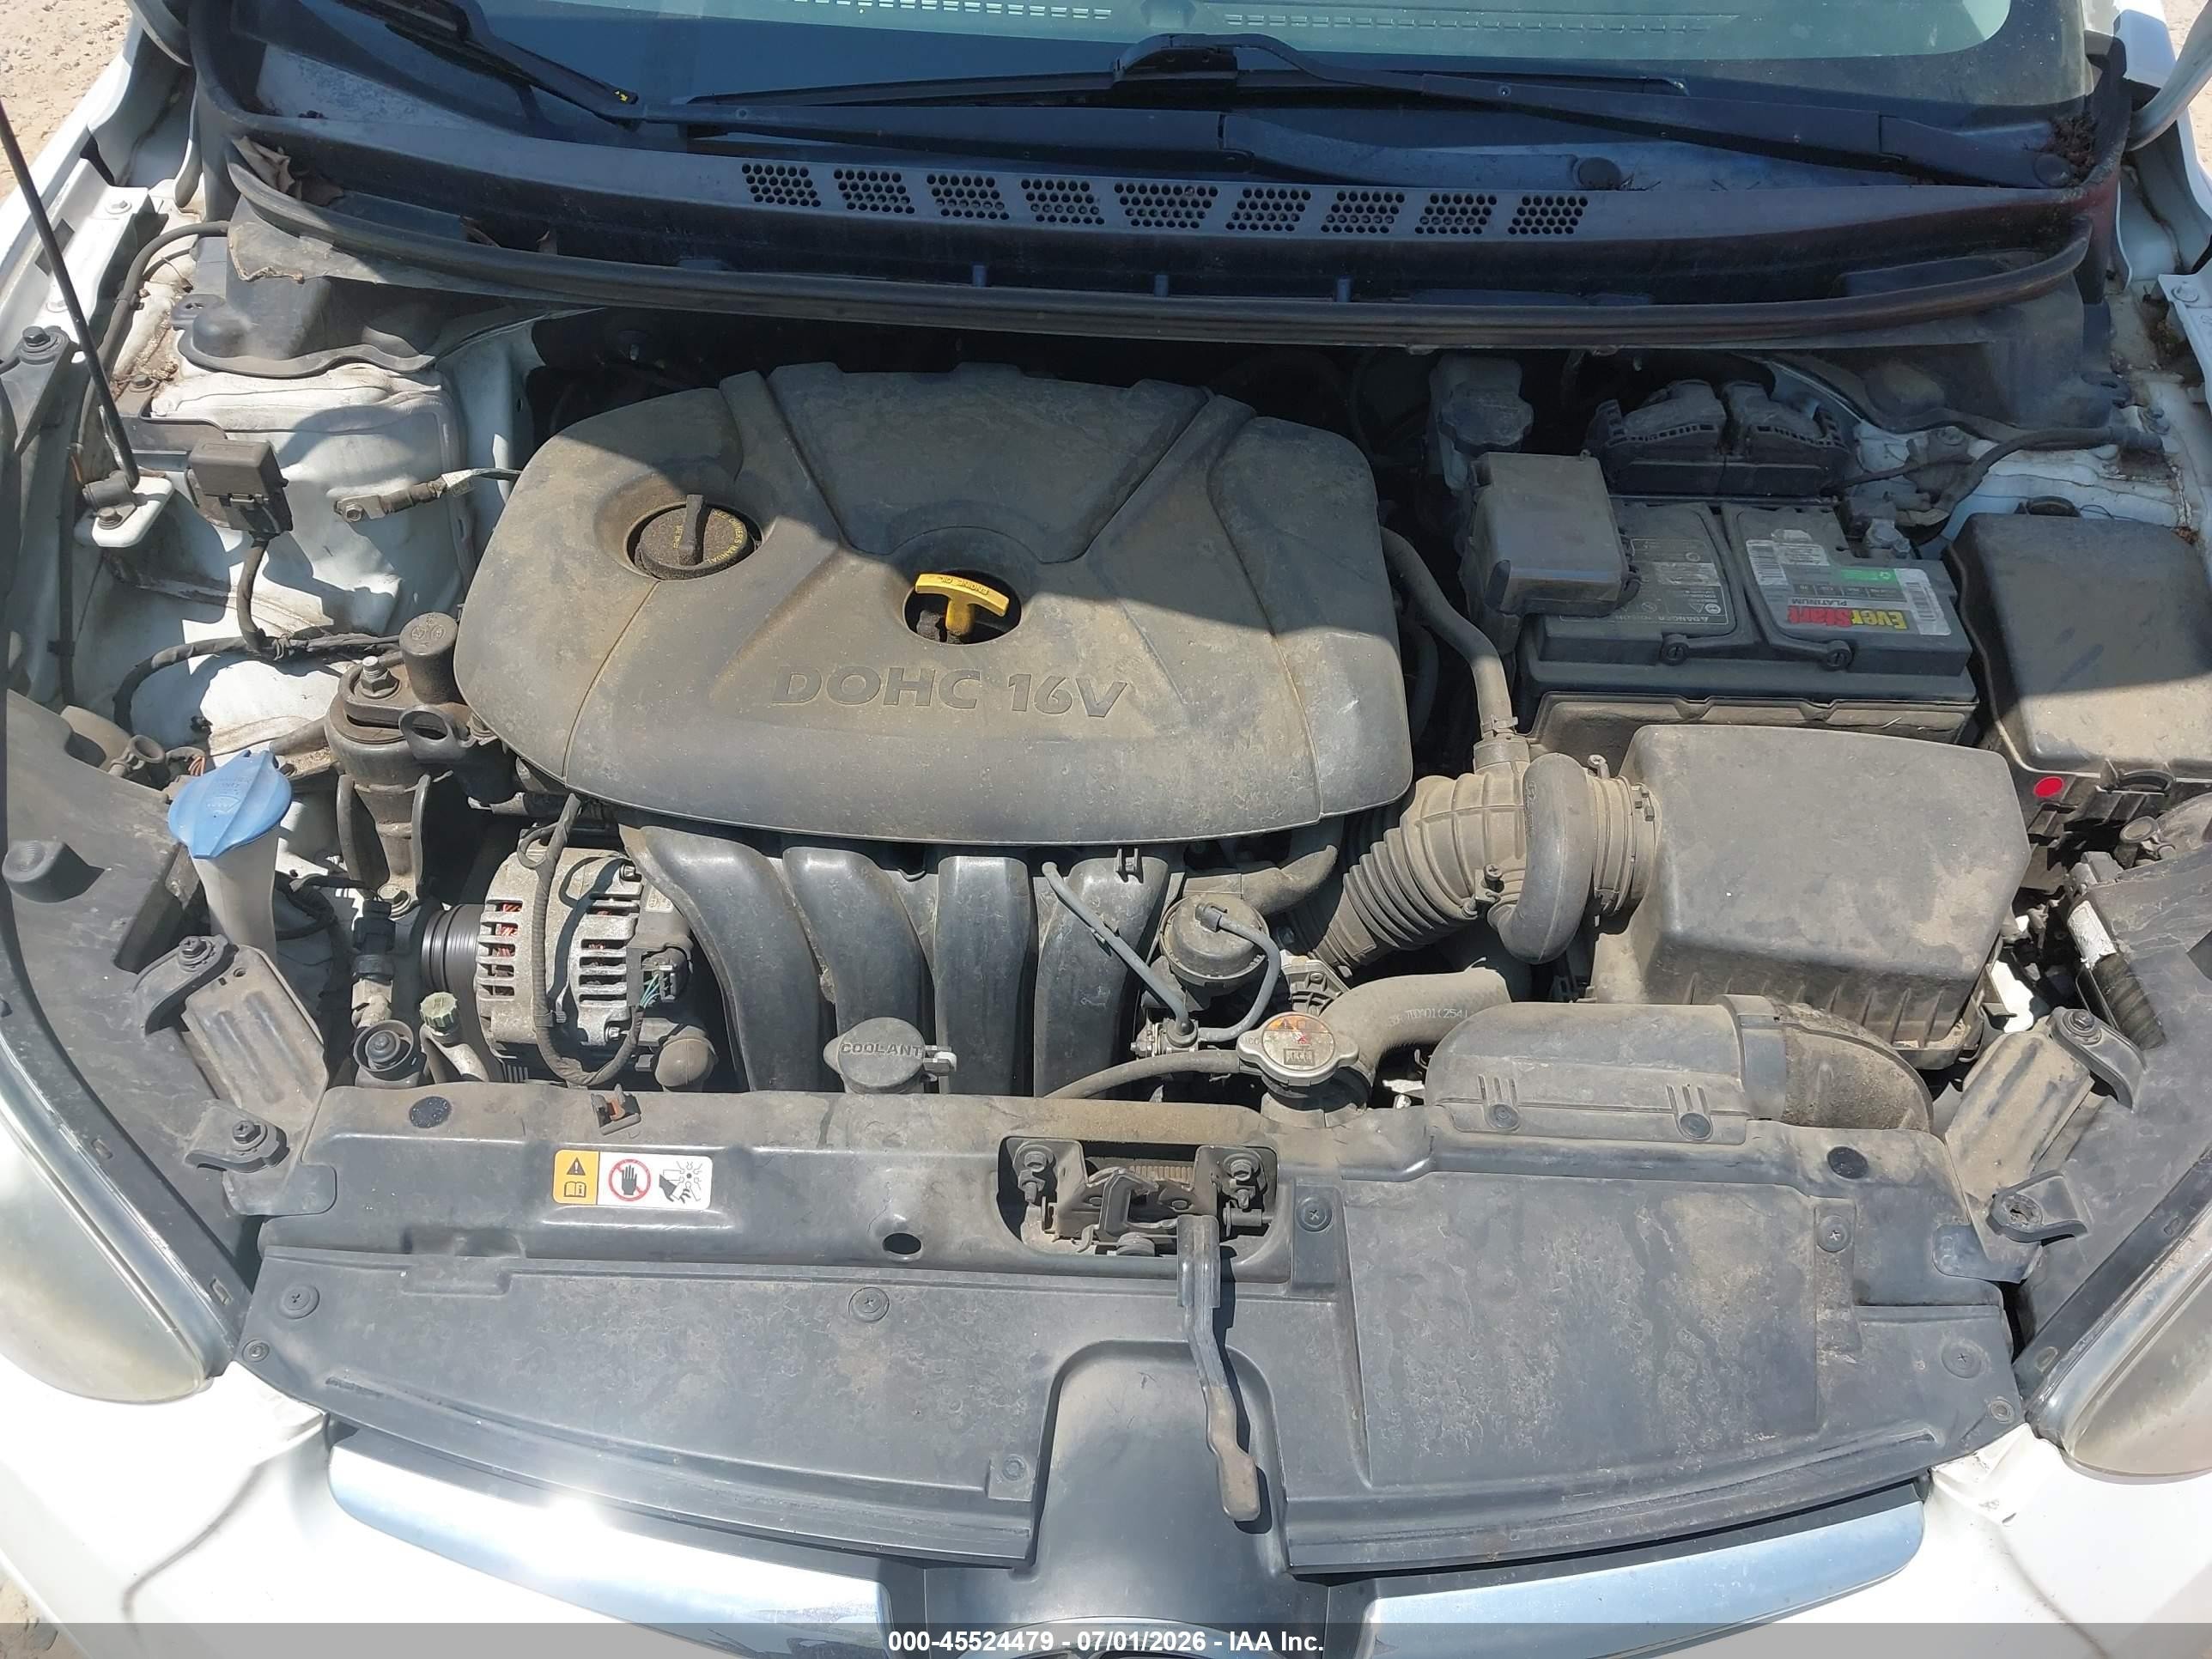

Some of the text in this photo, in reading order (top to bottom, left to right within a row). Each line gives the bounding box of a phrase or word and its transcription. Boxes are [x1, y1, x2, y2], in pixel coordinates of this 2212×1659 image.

[957, 578, 989, 595] ENGINE
[1791, 598, 1848, 606] PLATINUM
[772, 665, 1128, 718] DOHC 16V
[841, 1042, 923, 1059] COOLANT
